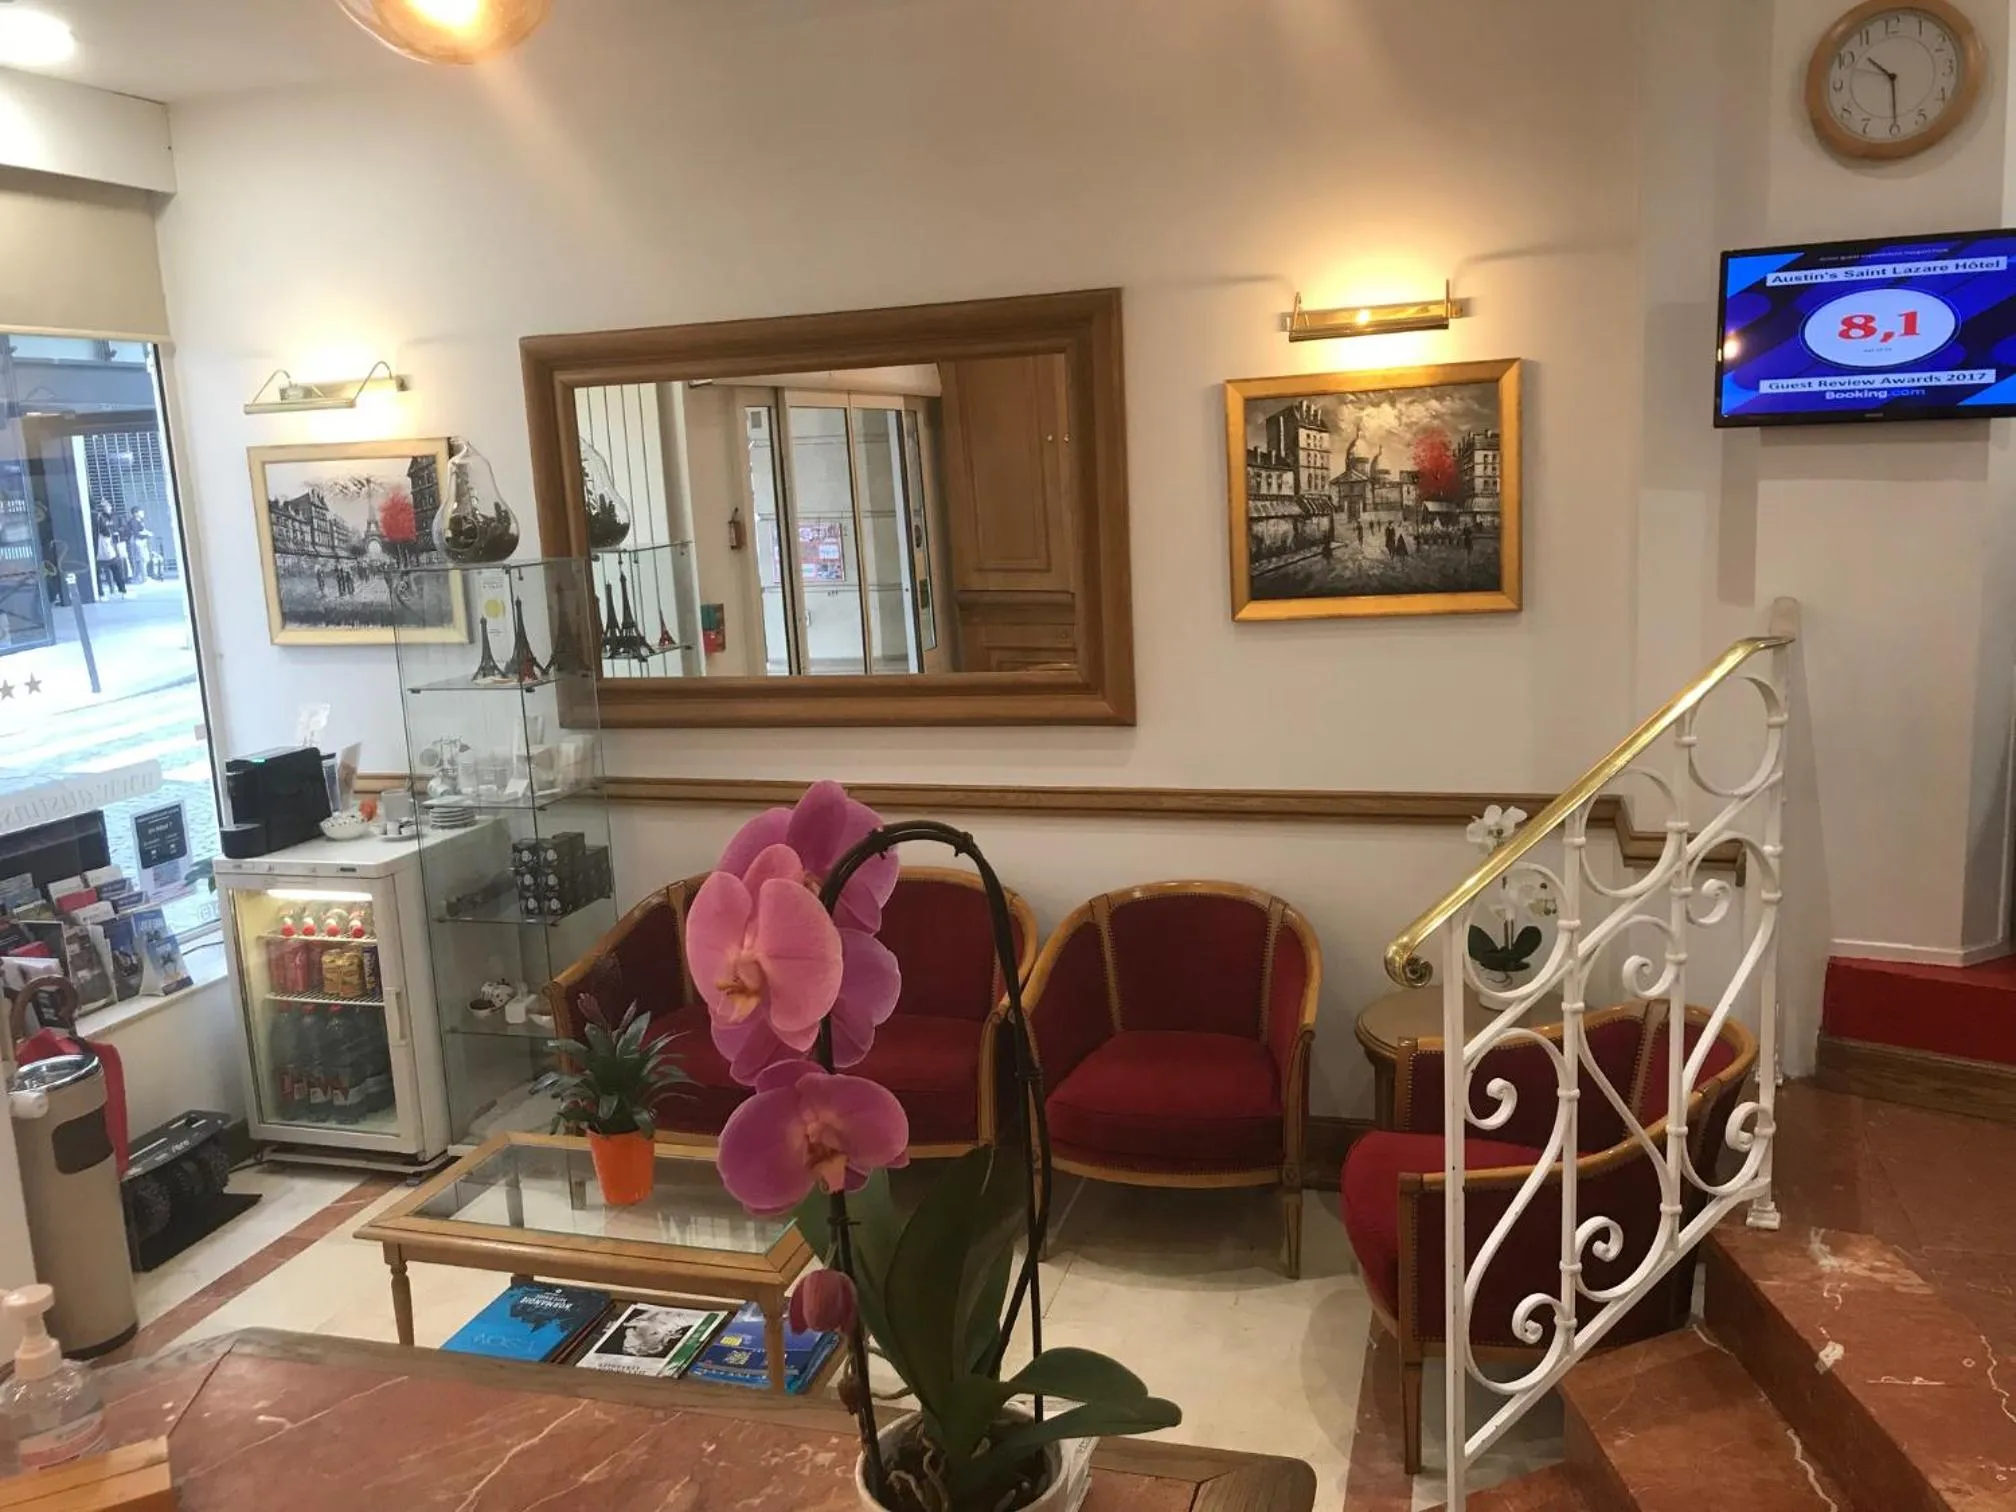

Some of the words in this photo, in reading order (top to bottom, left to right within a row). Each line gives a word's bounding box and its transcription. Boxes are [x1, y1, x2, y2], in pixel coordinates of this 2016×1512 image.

[1771, 271, 1838, 284] Austin's
[1843, 268, 1887, 278] Saint
[1892, 265, 1949, 275] Lazare
[1954, 259, 2000, 270] Hôtel
[1838, 310, 1920, 343] 8,1
[1768, 381, 1813, 391] Guest
[1818, 379, 1876, 388] Review
[1881, 374, 1941, 385] Awards
[1947, 372, 1987, 382] 2017
[1825, 388, 1926, 400] Booking.com
